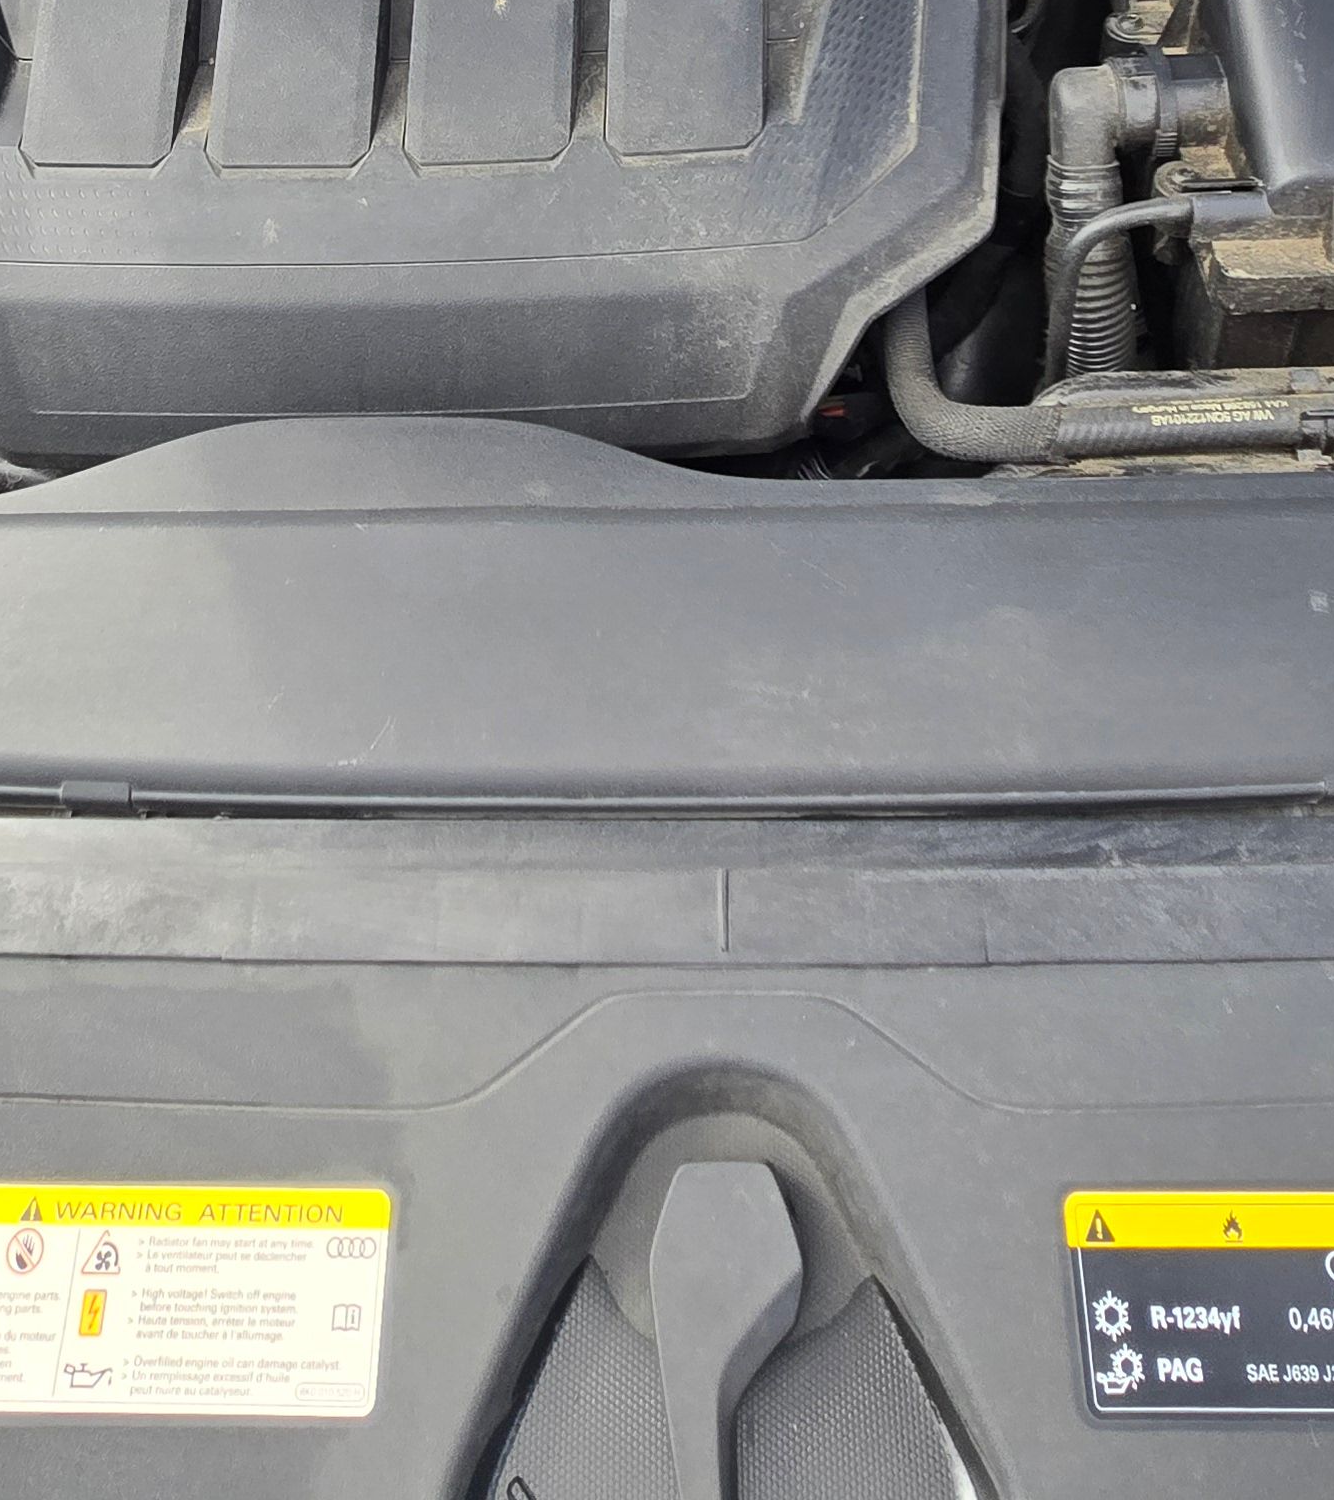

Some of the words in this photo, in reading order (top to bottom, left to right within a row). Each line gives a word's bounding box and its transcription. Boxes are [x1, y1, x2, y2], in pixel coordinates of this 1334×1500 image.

[1232, 410, 1251, 423] AG
[55, 1201, 182, 1222] WARNING
[198, 1203, 344, 1223] ATTENTION
[148, 1236, 189, 1247] Radiator
[192, 1237, 208, 1247] fan
[210, 1239, 230, 1249] may
[234, 1239, 255, 1248] start
[259, 1239, 268, 1248] at
[270, 1241, 287, 1250] any
[146, 1251, 158, 1260] Le
[161, 1251, 213, 1260] ventilateur
[215, 1253, 237, 1265] peut
[254, 1252, 307, 1261] déclencher
[145, 1264, 151, 1273] à
[154, 1264, 173, 1273] tout
[176, 1265, 219, 1274] moment.
[34, 1292, 61, 1302] parts.
[141, 1288, 165, 1303] High
[167, 1288, 208, 1301] voltage!
[210, 1289, 244, 1300] Switch
[247, 1289, 260, 1299] off
[262, 1292, 296, 1303] engine
[15, 1305, 43, 1315] parts.
[139, 1302, 171, 1312] before
[174, 1303, 217, 1315] touching
[220, 1303, 258, 1314] ignition
[260, 1304, 298, 1316] system.
[138, 1315, 167, 1325] Haute
[170, 1317, 208, 1327] tension,
[212, 1317, 244, 1327] arrêter
[248, 1316, 256, 1326] le
[259, 1318, 295, 1327] moteur
[1150, 1305, 1242, 1336] R-1234yf
[4, 1330, 16, 1342] du
[20, 1332, 56, 1342] moteur
[136, 1330, 163, 1339] avant
[166, 1329, 178, 1339] de
[181, 1330, 218, 1340] toucher
[0, 1360, 11, 1368] en
[133, 1355, 183, 1368] Overfilled
[184, 1358, 219, 1371] engine
[222, 1356, 234, 1368] oil
[236, 1360, 254, 1368] can
[257, 1358, 298, 1372] damage
[300, 1358, 340, 1372] catalyst.
[1157, 1358, 1204, 1383] PAG
[1246, 1363, 1279, 1382] SAE
[1283, 1363, 1320, 1383] J639
[132, 1371, 146, 1381] Un
[149, 1371, 210, 1384] remplissage
[213, 1372, 254, 1383] excessif
[255, 1372, 290, 1383] d'huile
[129, 1385, 153, 1397] peut
[155, 1385, 181, 1396] nuire
[184, 1386, 196, 1396] au
[198, 1386, 252, 1397] catalyseur.
